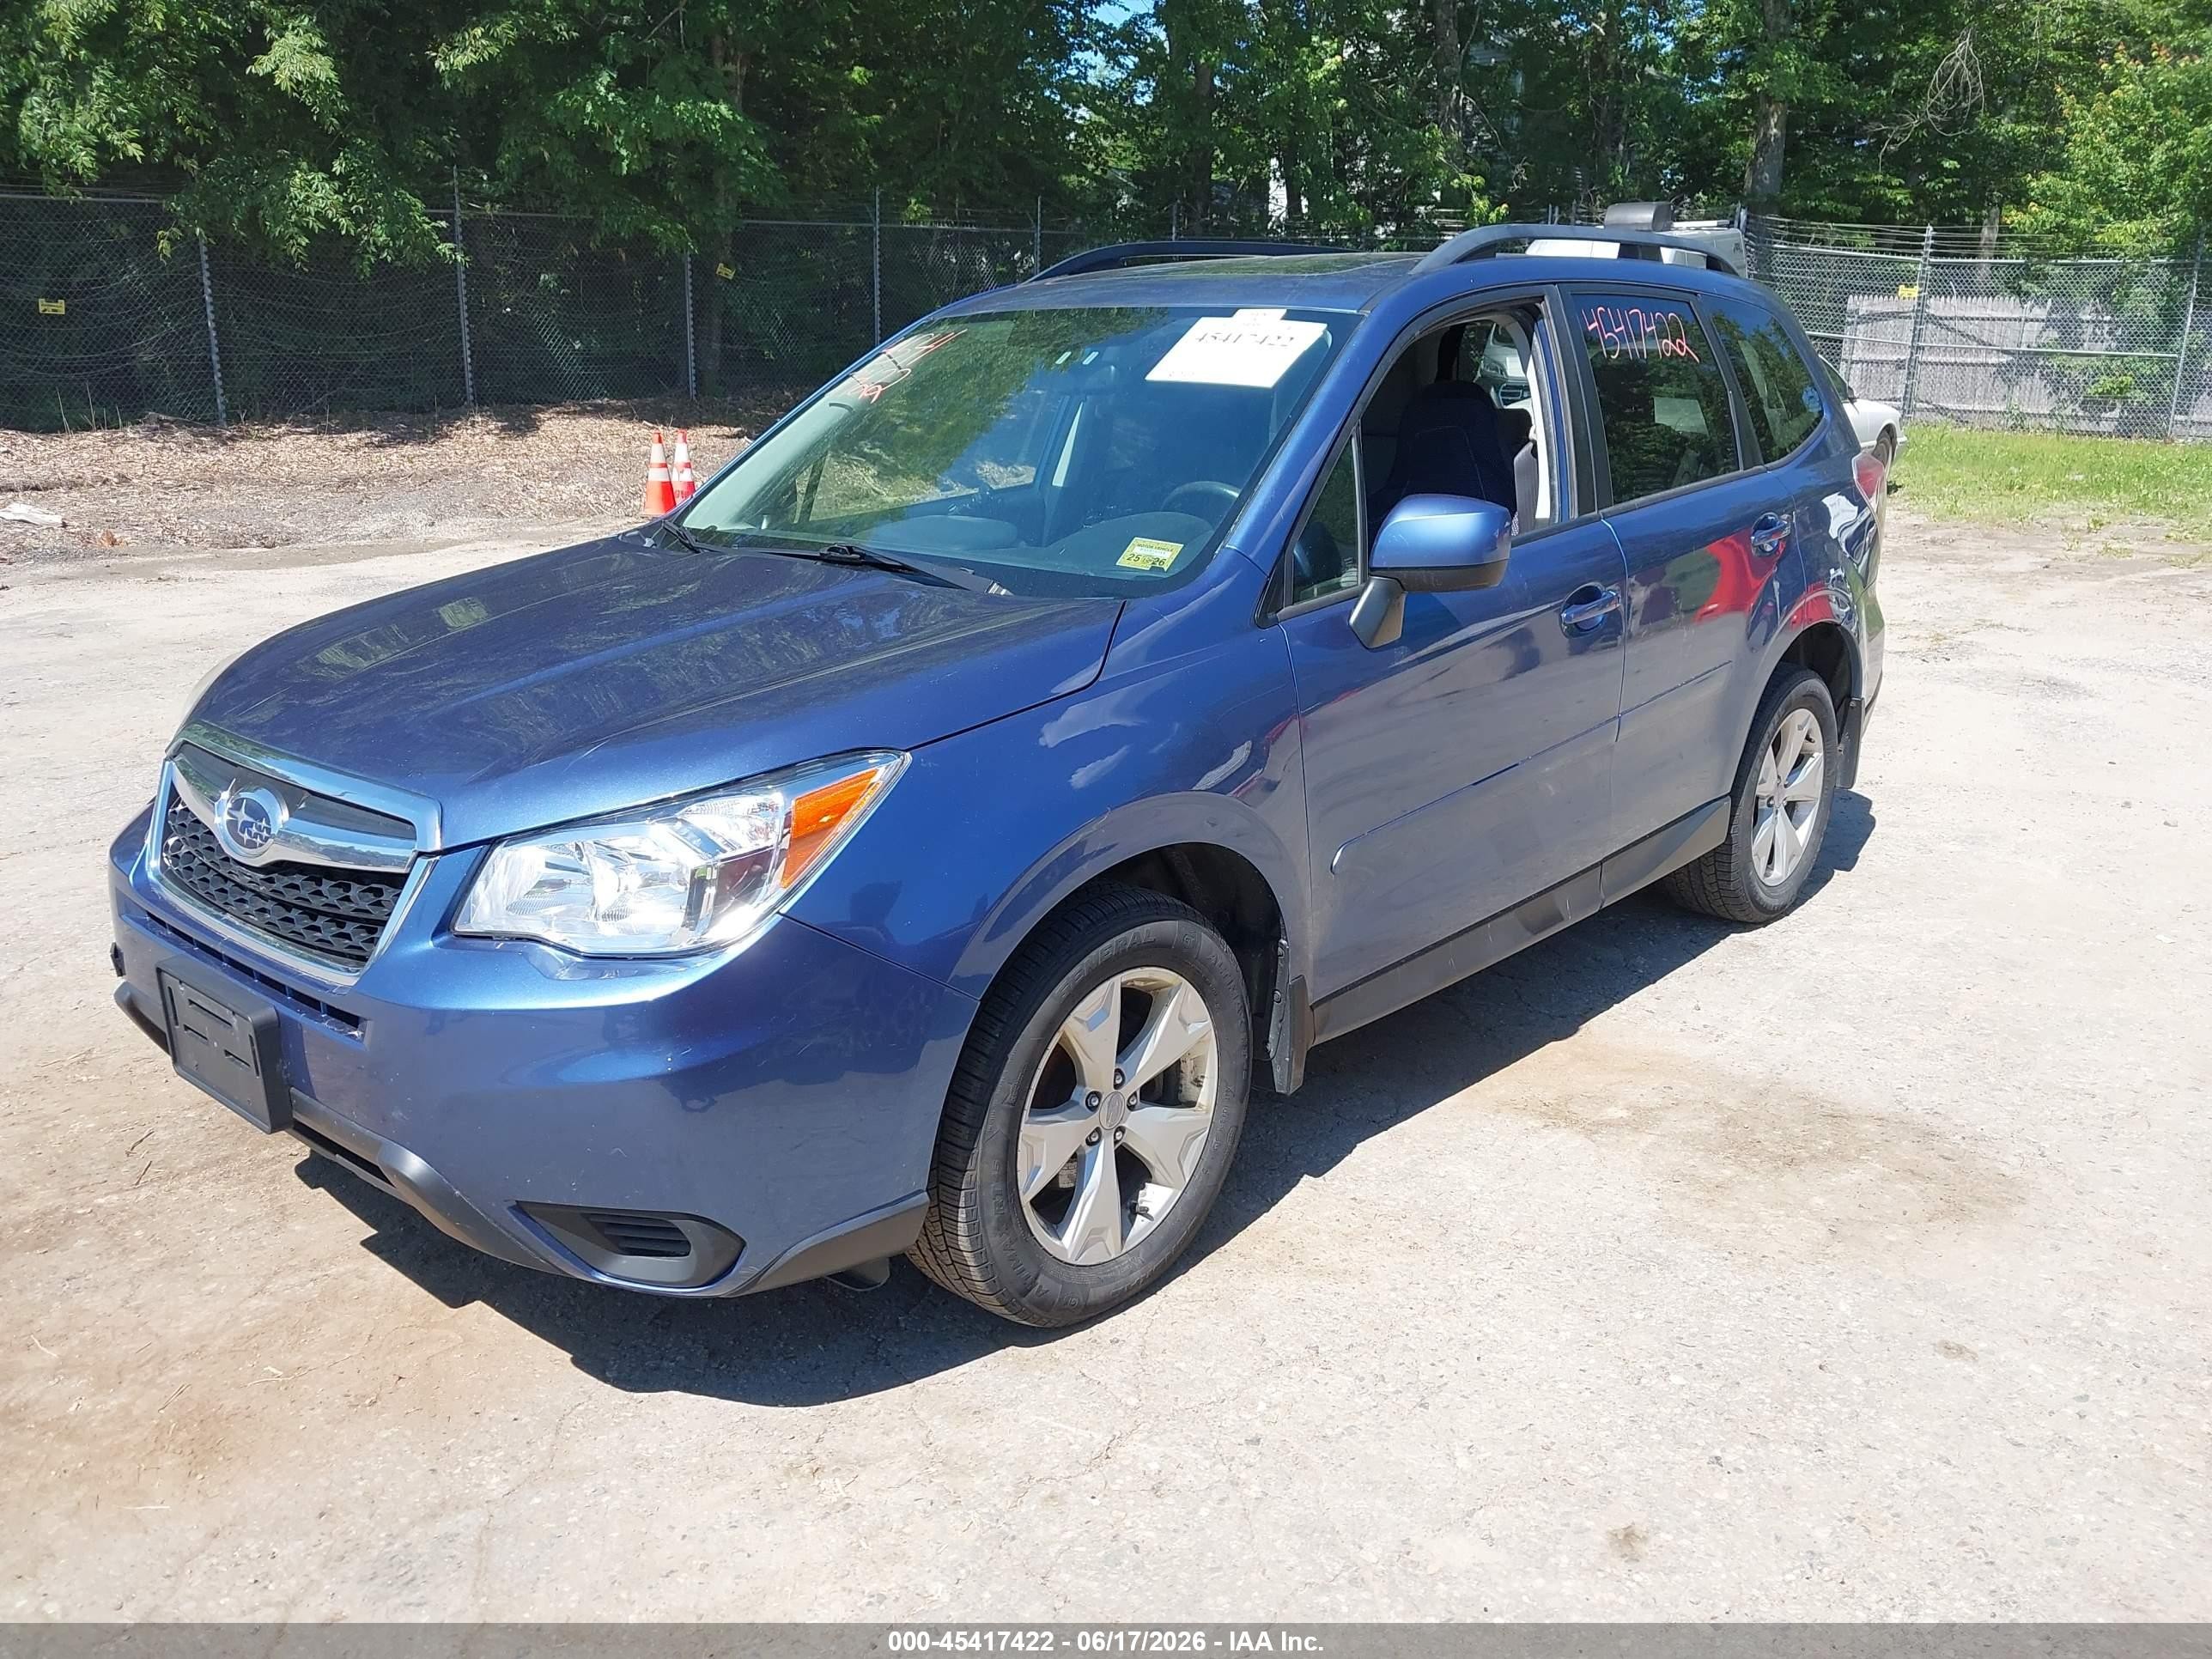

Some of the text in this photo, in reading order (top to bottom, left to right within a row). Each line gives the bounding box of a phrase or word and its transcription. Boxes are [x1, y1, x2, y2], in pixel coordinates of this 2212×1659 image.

[1581, 305, 1700, 364] 45417422
[1127, 553, 1141, 562] 25
[1152, 557, 1167, 566] 26
